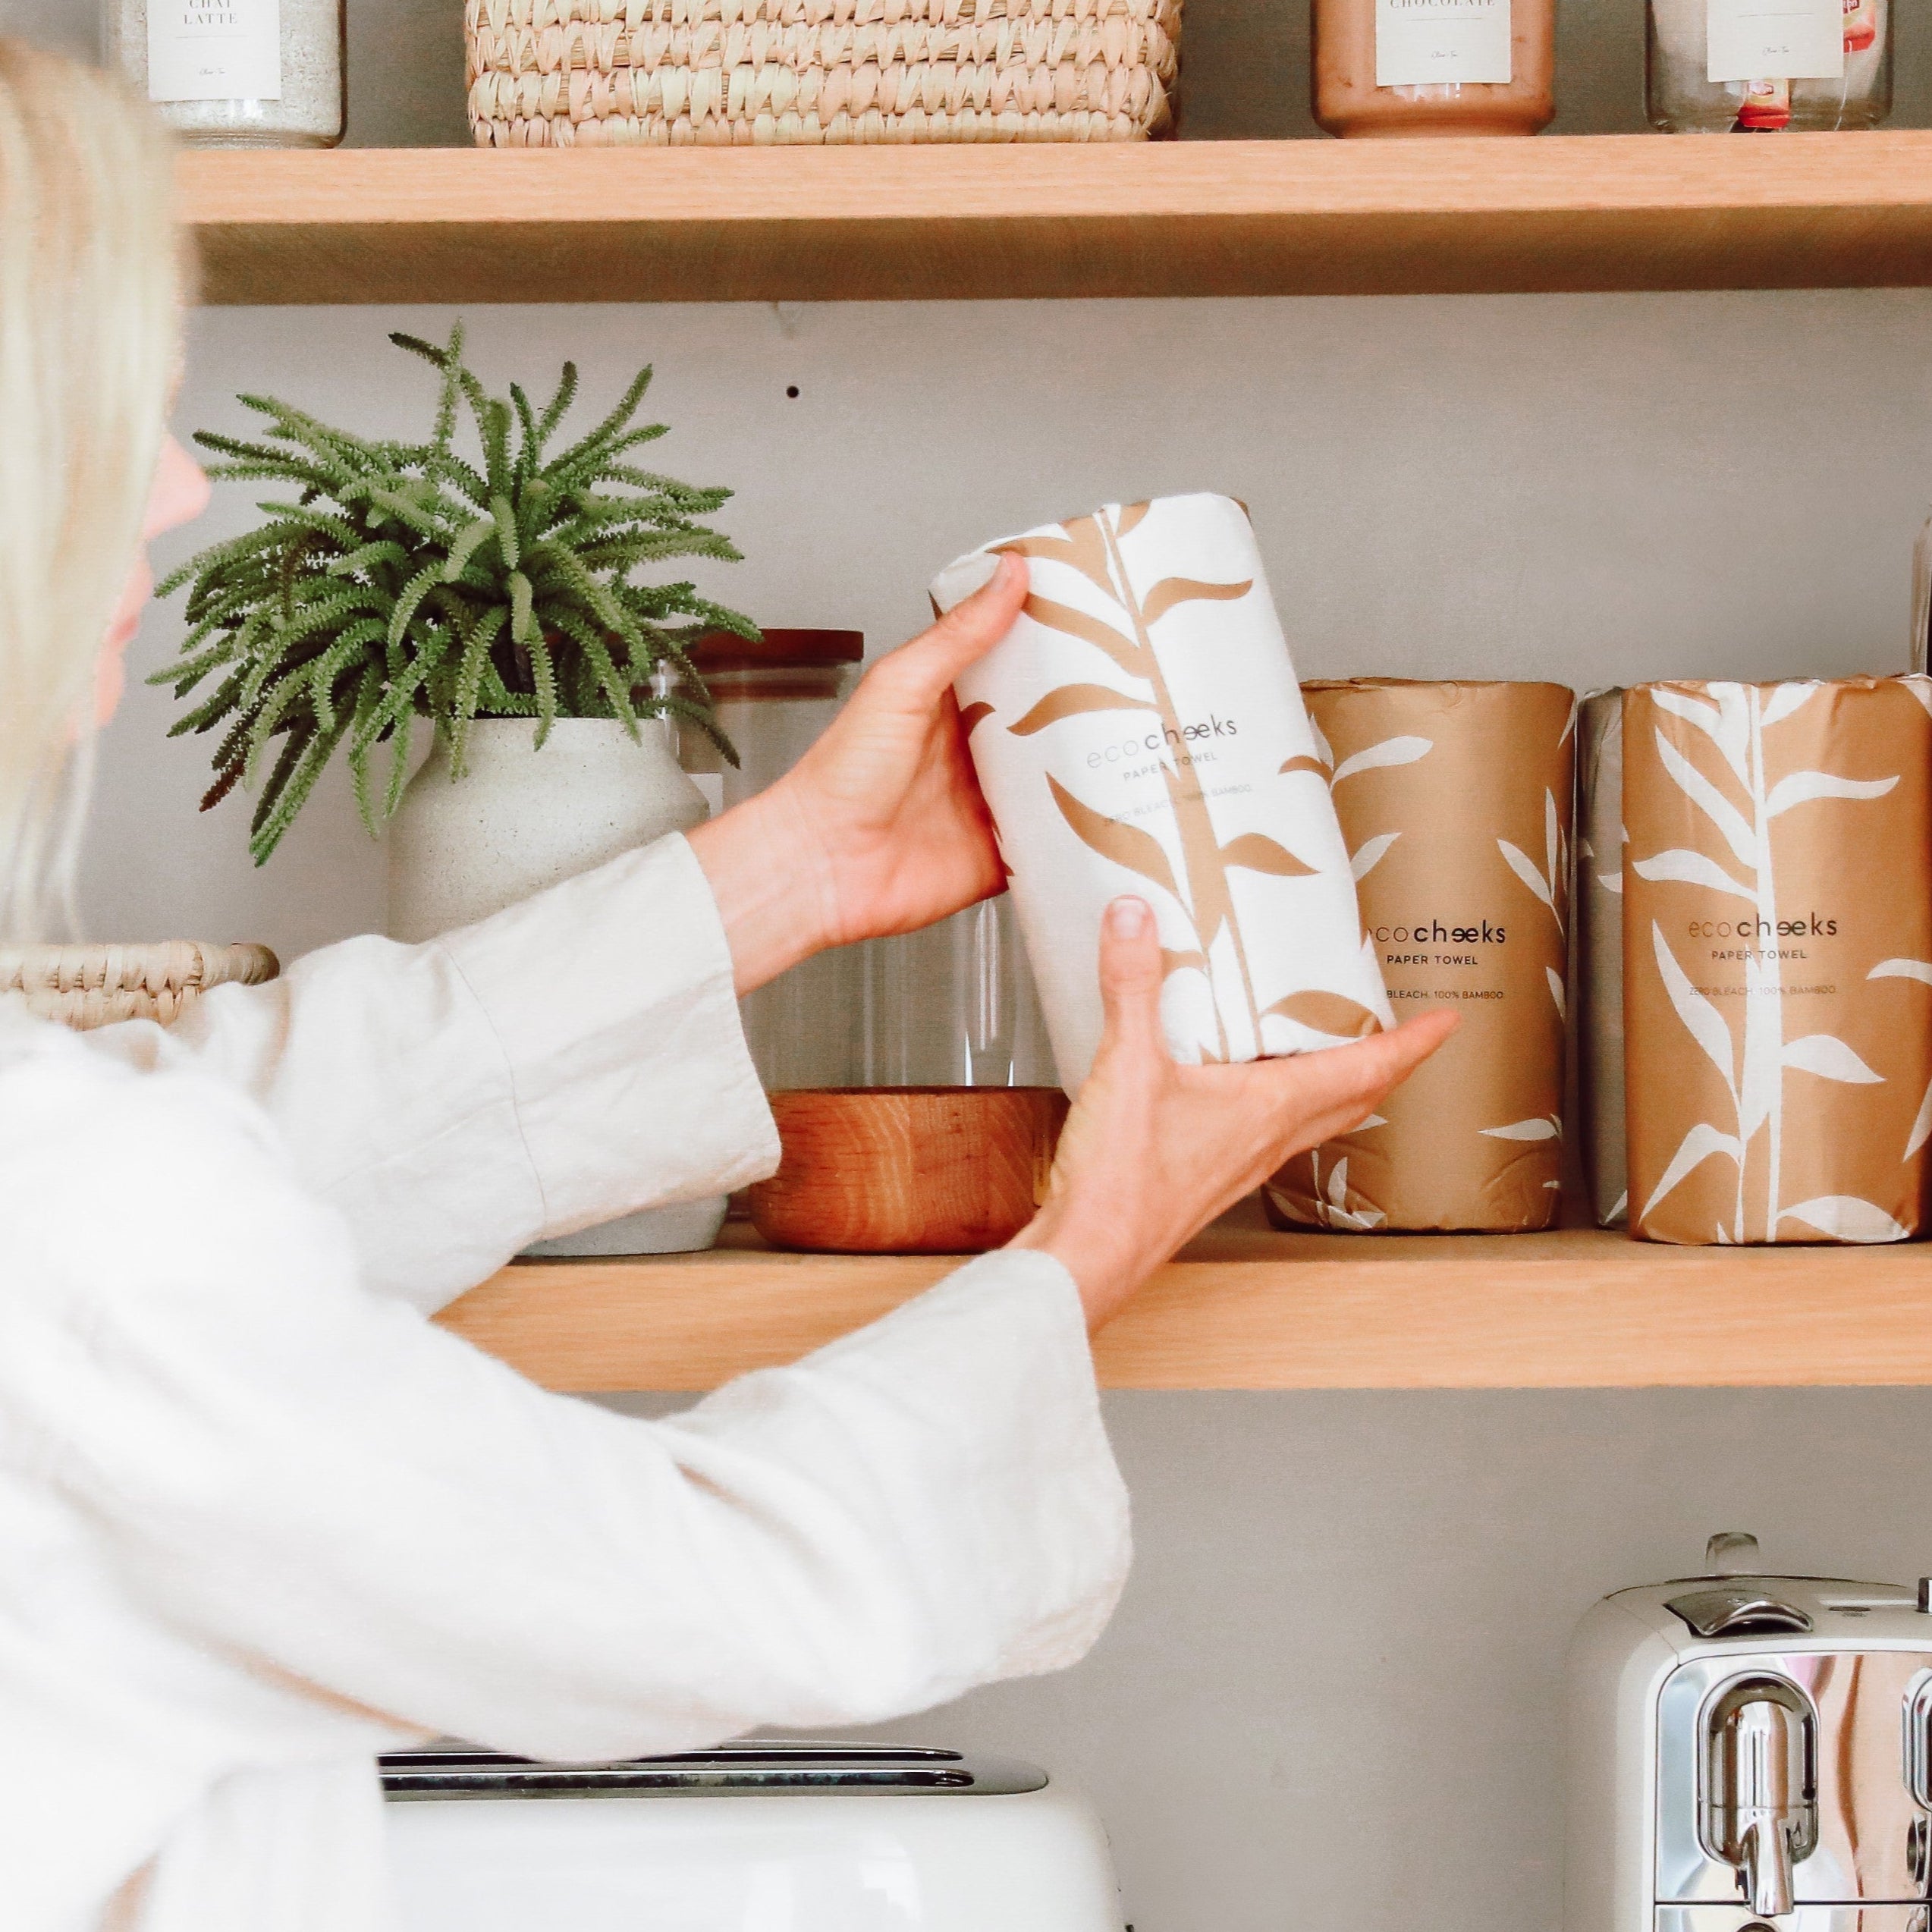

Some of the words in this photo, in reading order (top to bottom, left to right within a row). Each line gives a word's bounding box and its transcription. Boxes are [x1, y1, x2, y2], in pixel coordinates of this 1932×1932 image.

[184, 14, 237, 24] LATTE
[1123, 761, 1169, 781] PAPER
[1173, 752, 1217, 766] TOWEL
[1367, 919, 1506, 944] cocheeks
[1387, 954, 1428, 965] PAPER
[1434, 955, 1478, 965] TOWEL
[1711, 950, 1754, 960] PAPER
[1758, 949, 1807, 960] TOWEL
[1434, 991, 1459, 999] 100%
[1462, 991, 1504, 1000] BAMBOO
[1789, 985, 1836, 995] BAMBOO
